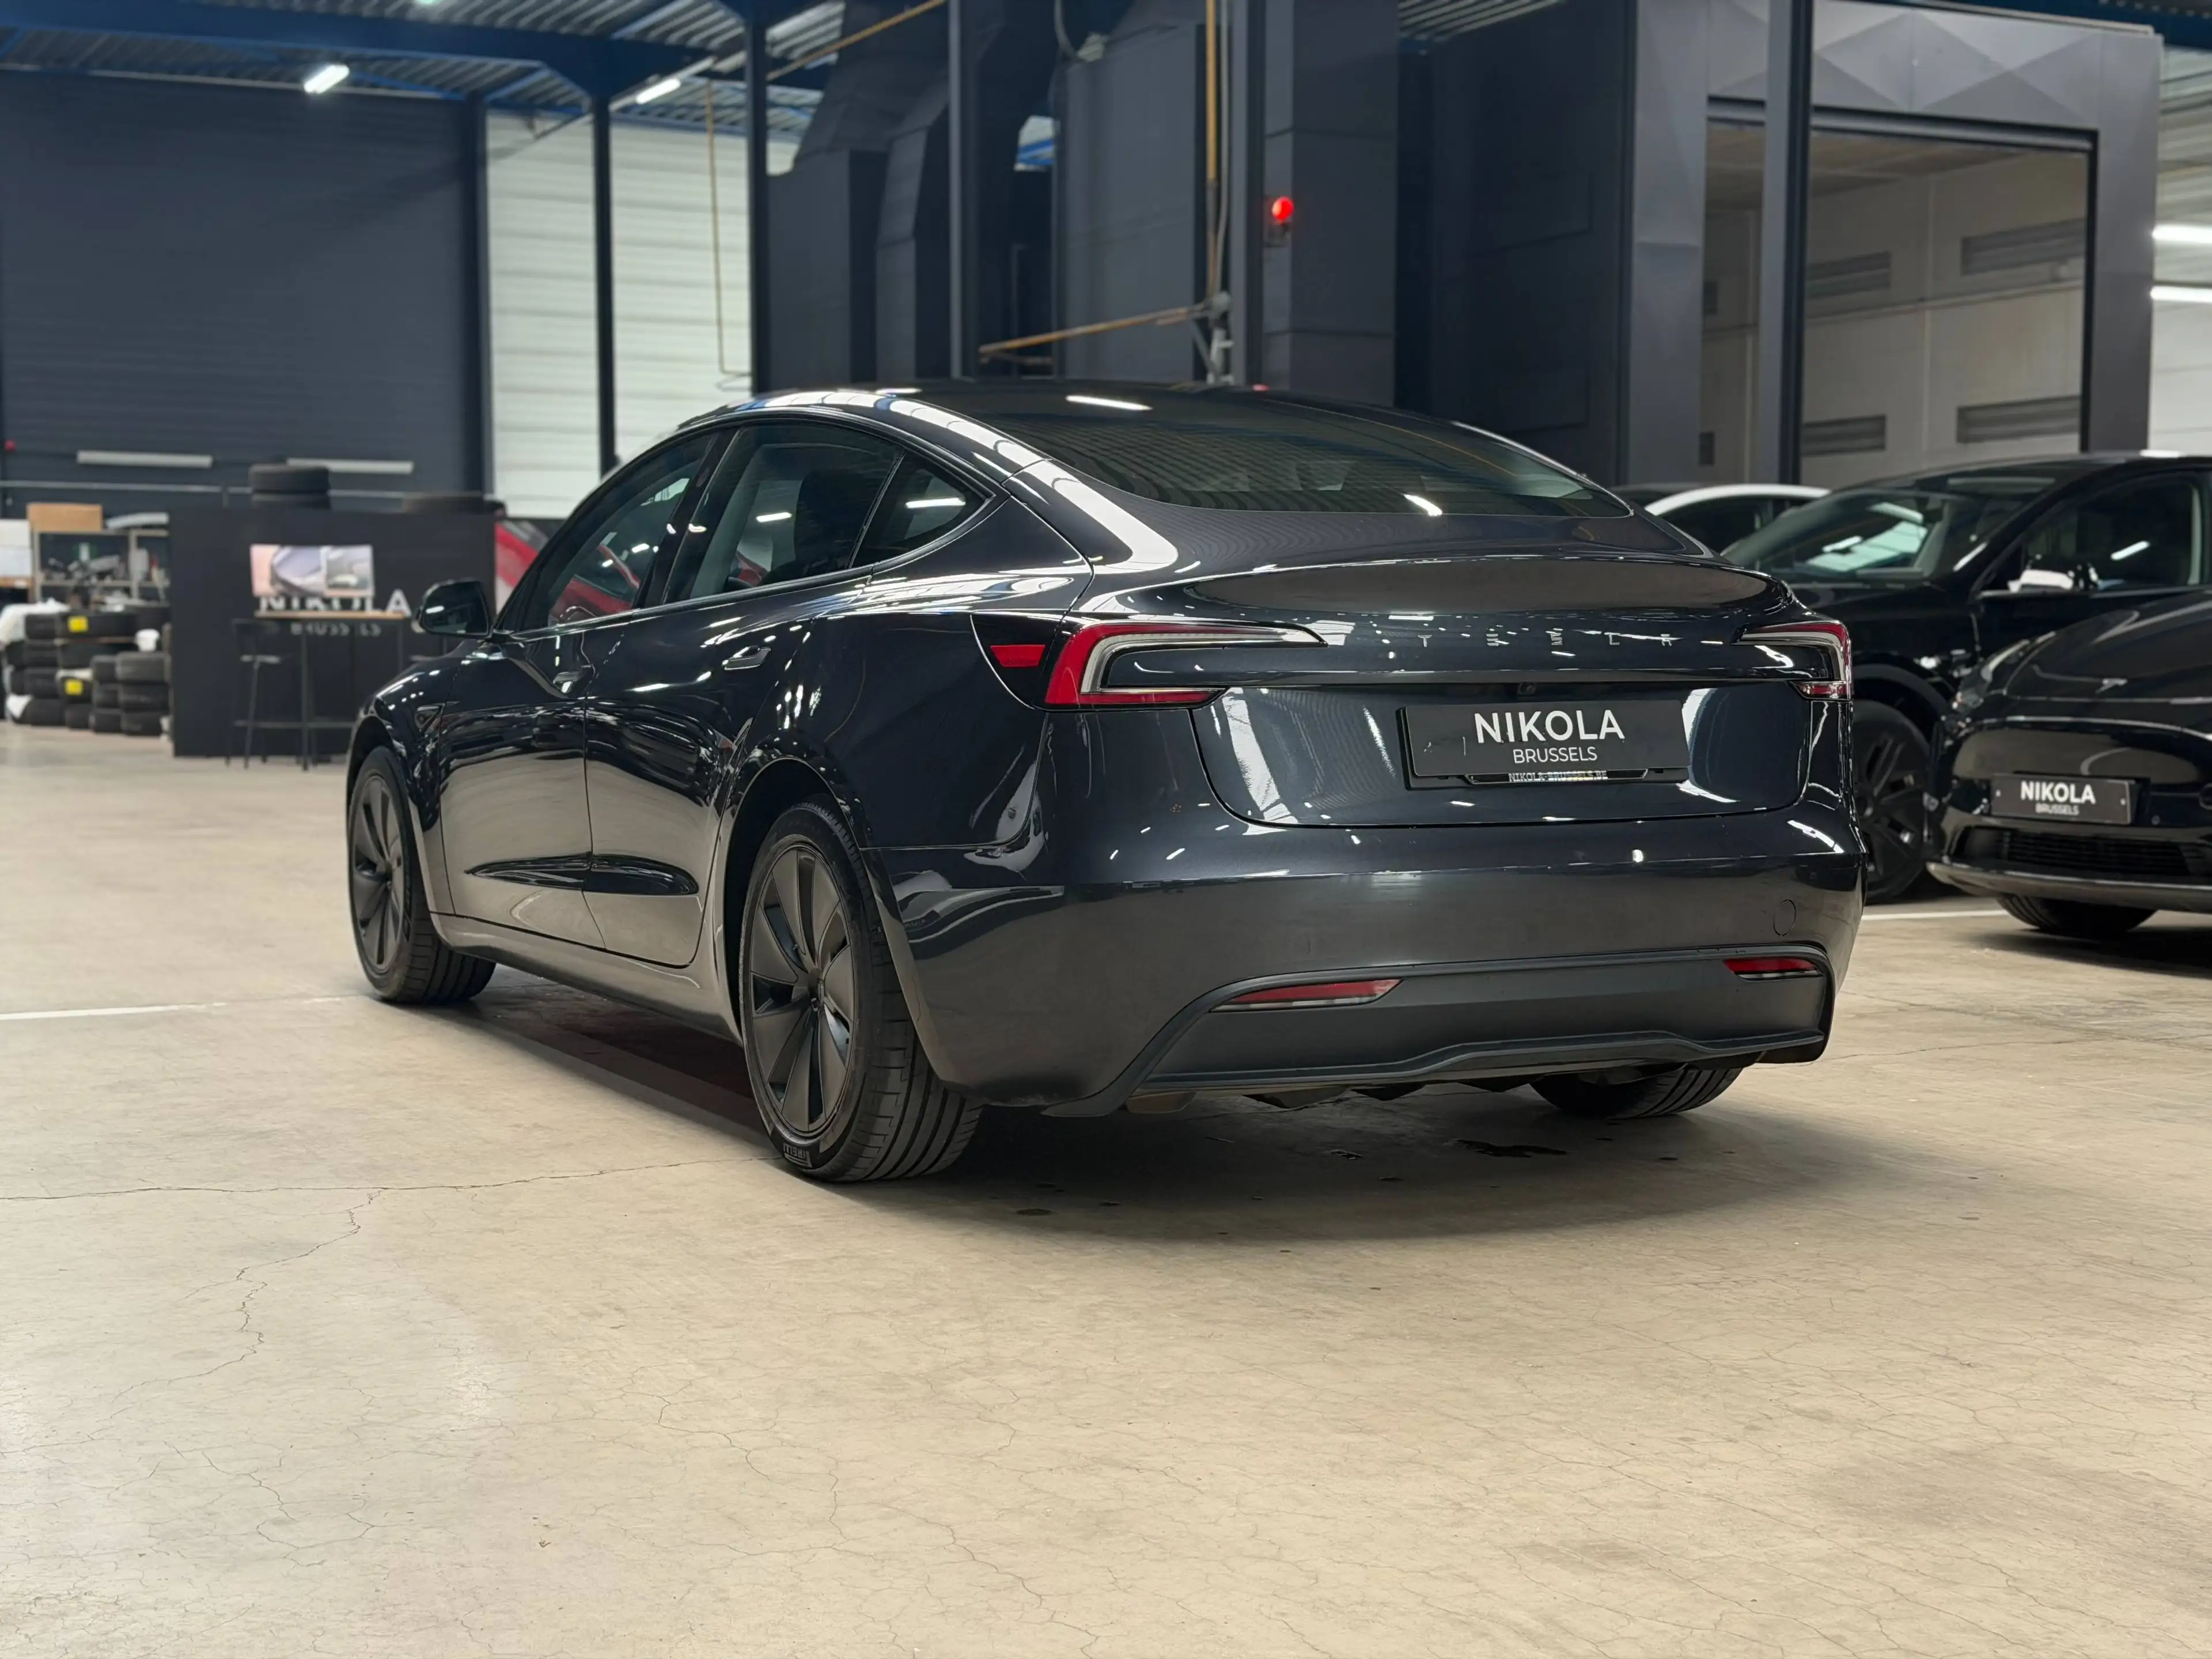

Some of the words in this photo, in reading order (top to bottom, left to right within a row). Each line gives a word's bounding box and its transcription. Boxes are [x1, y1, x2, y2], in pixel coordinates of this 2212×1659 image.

[1417, 633, 1672, 647] TESLA
[1474, 709, 1625, 744] NIKOLA
[1513, 747, 1598, 764] BRUSSELS
[2020, 780, 2096, 804] NIKOLA
